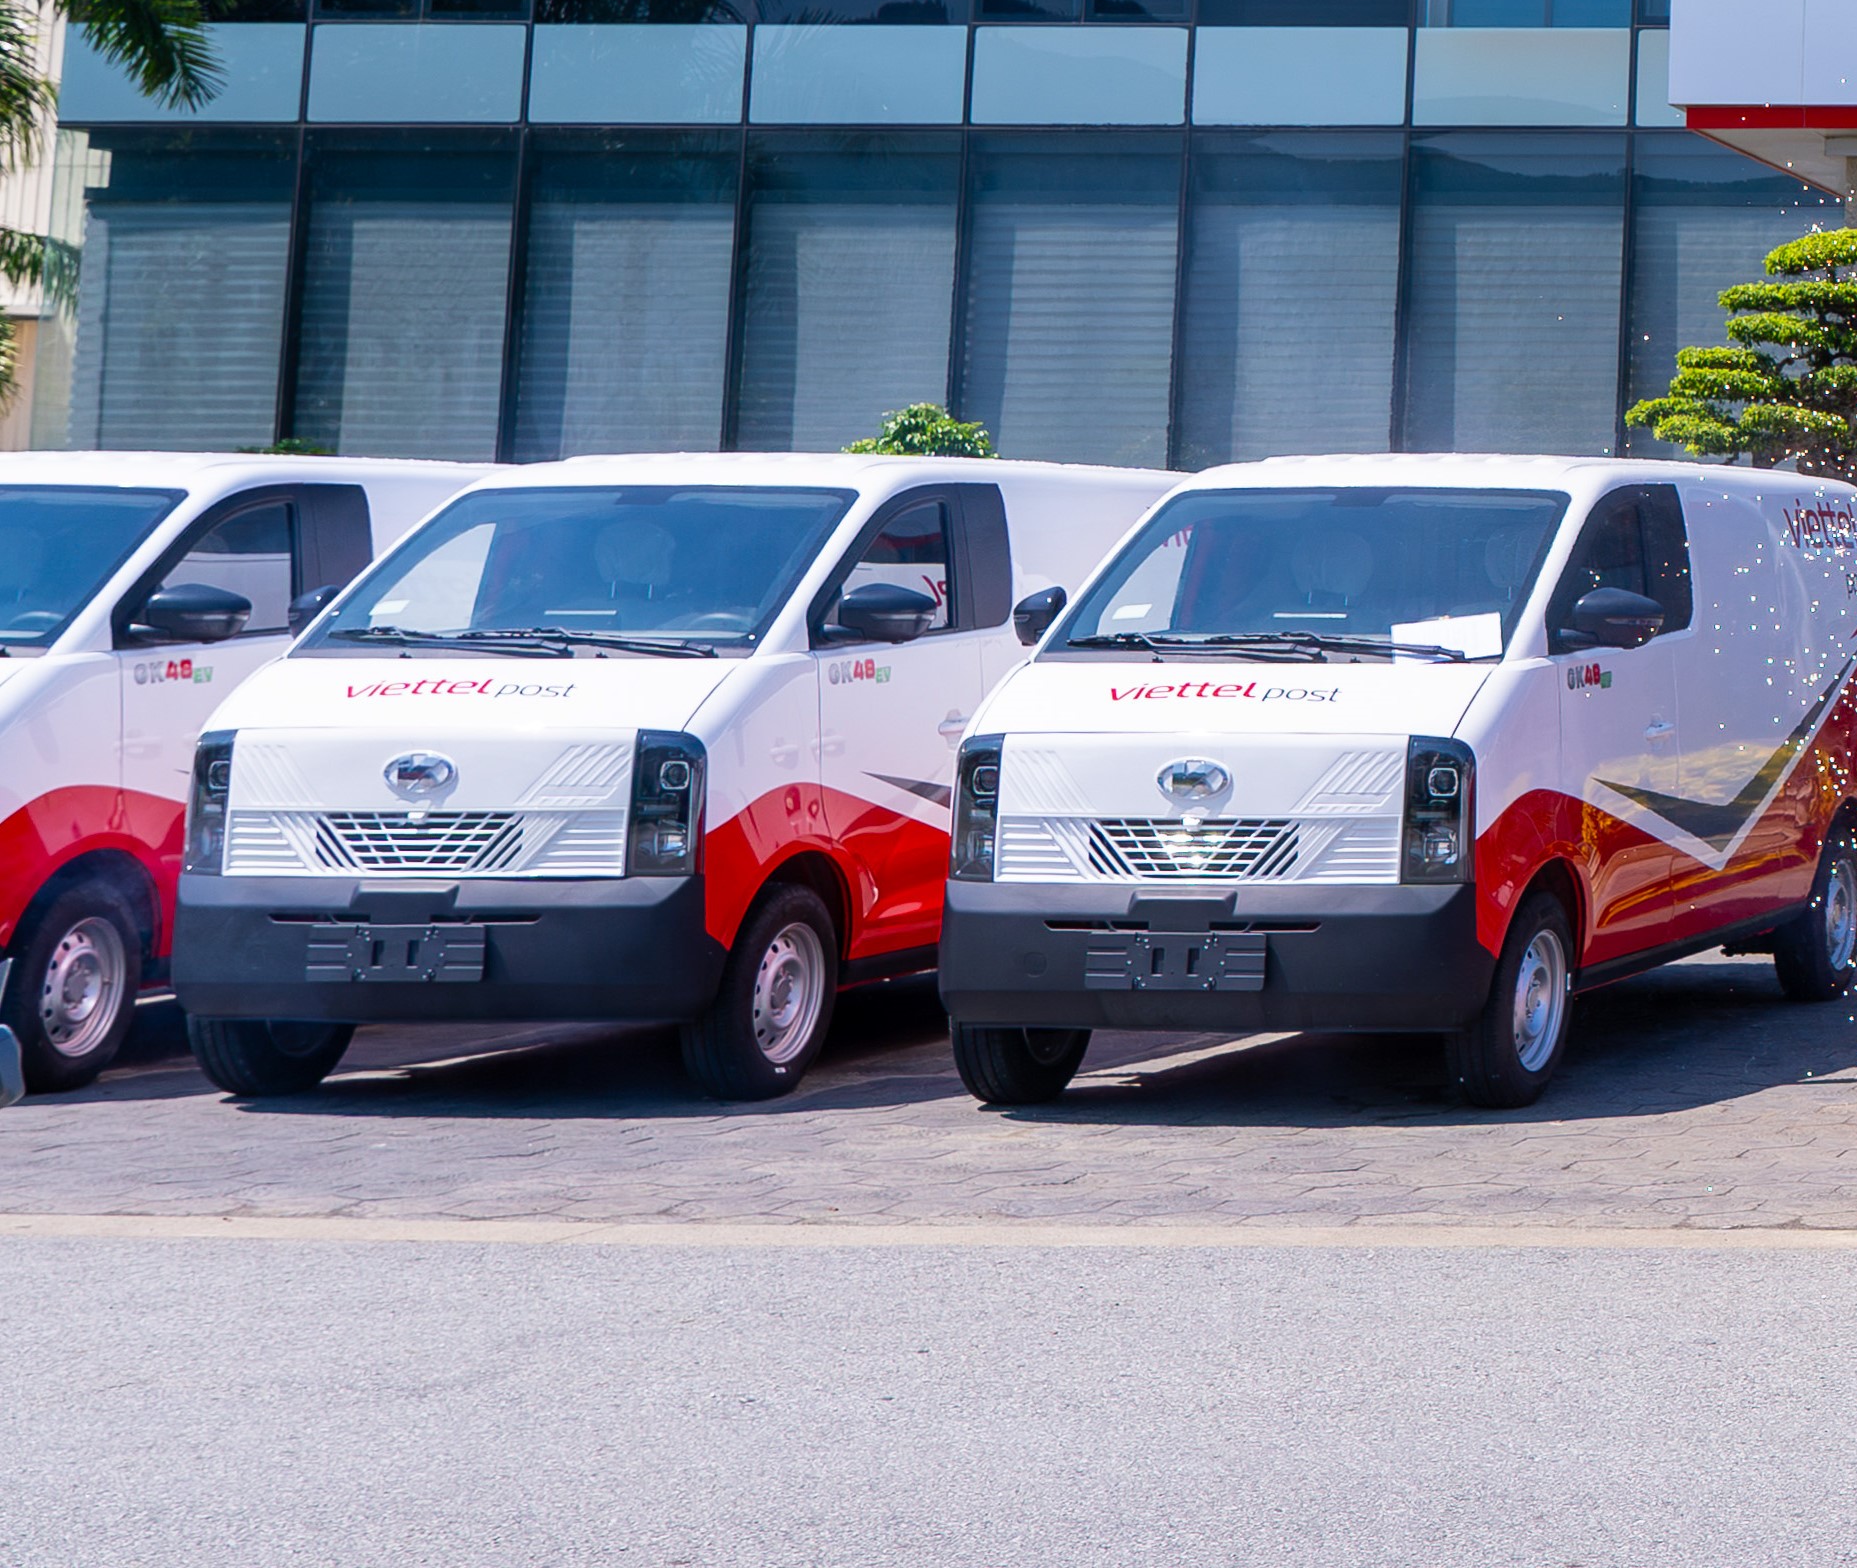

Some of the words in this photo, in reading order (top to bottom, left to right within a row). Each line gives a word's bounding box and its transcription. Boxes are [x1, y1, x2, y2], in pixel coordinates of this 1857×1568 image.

[347, 679, 494, 698] viettel
[494, 683, 577, 698] post
[1110, 682, 1257, 701] viettel
[1262, 687, 1342, 702] post
